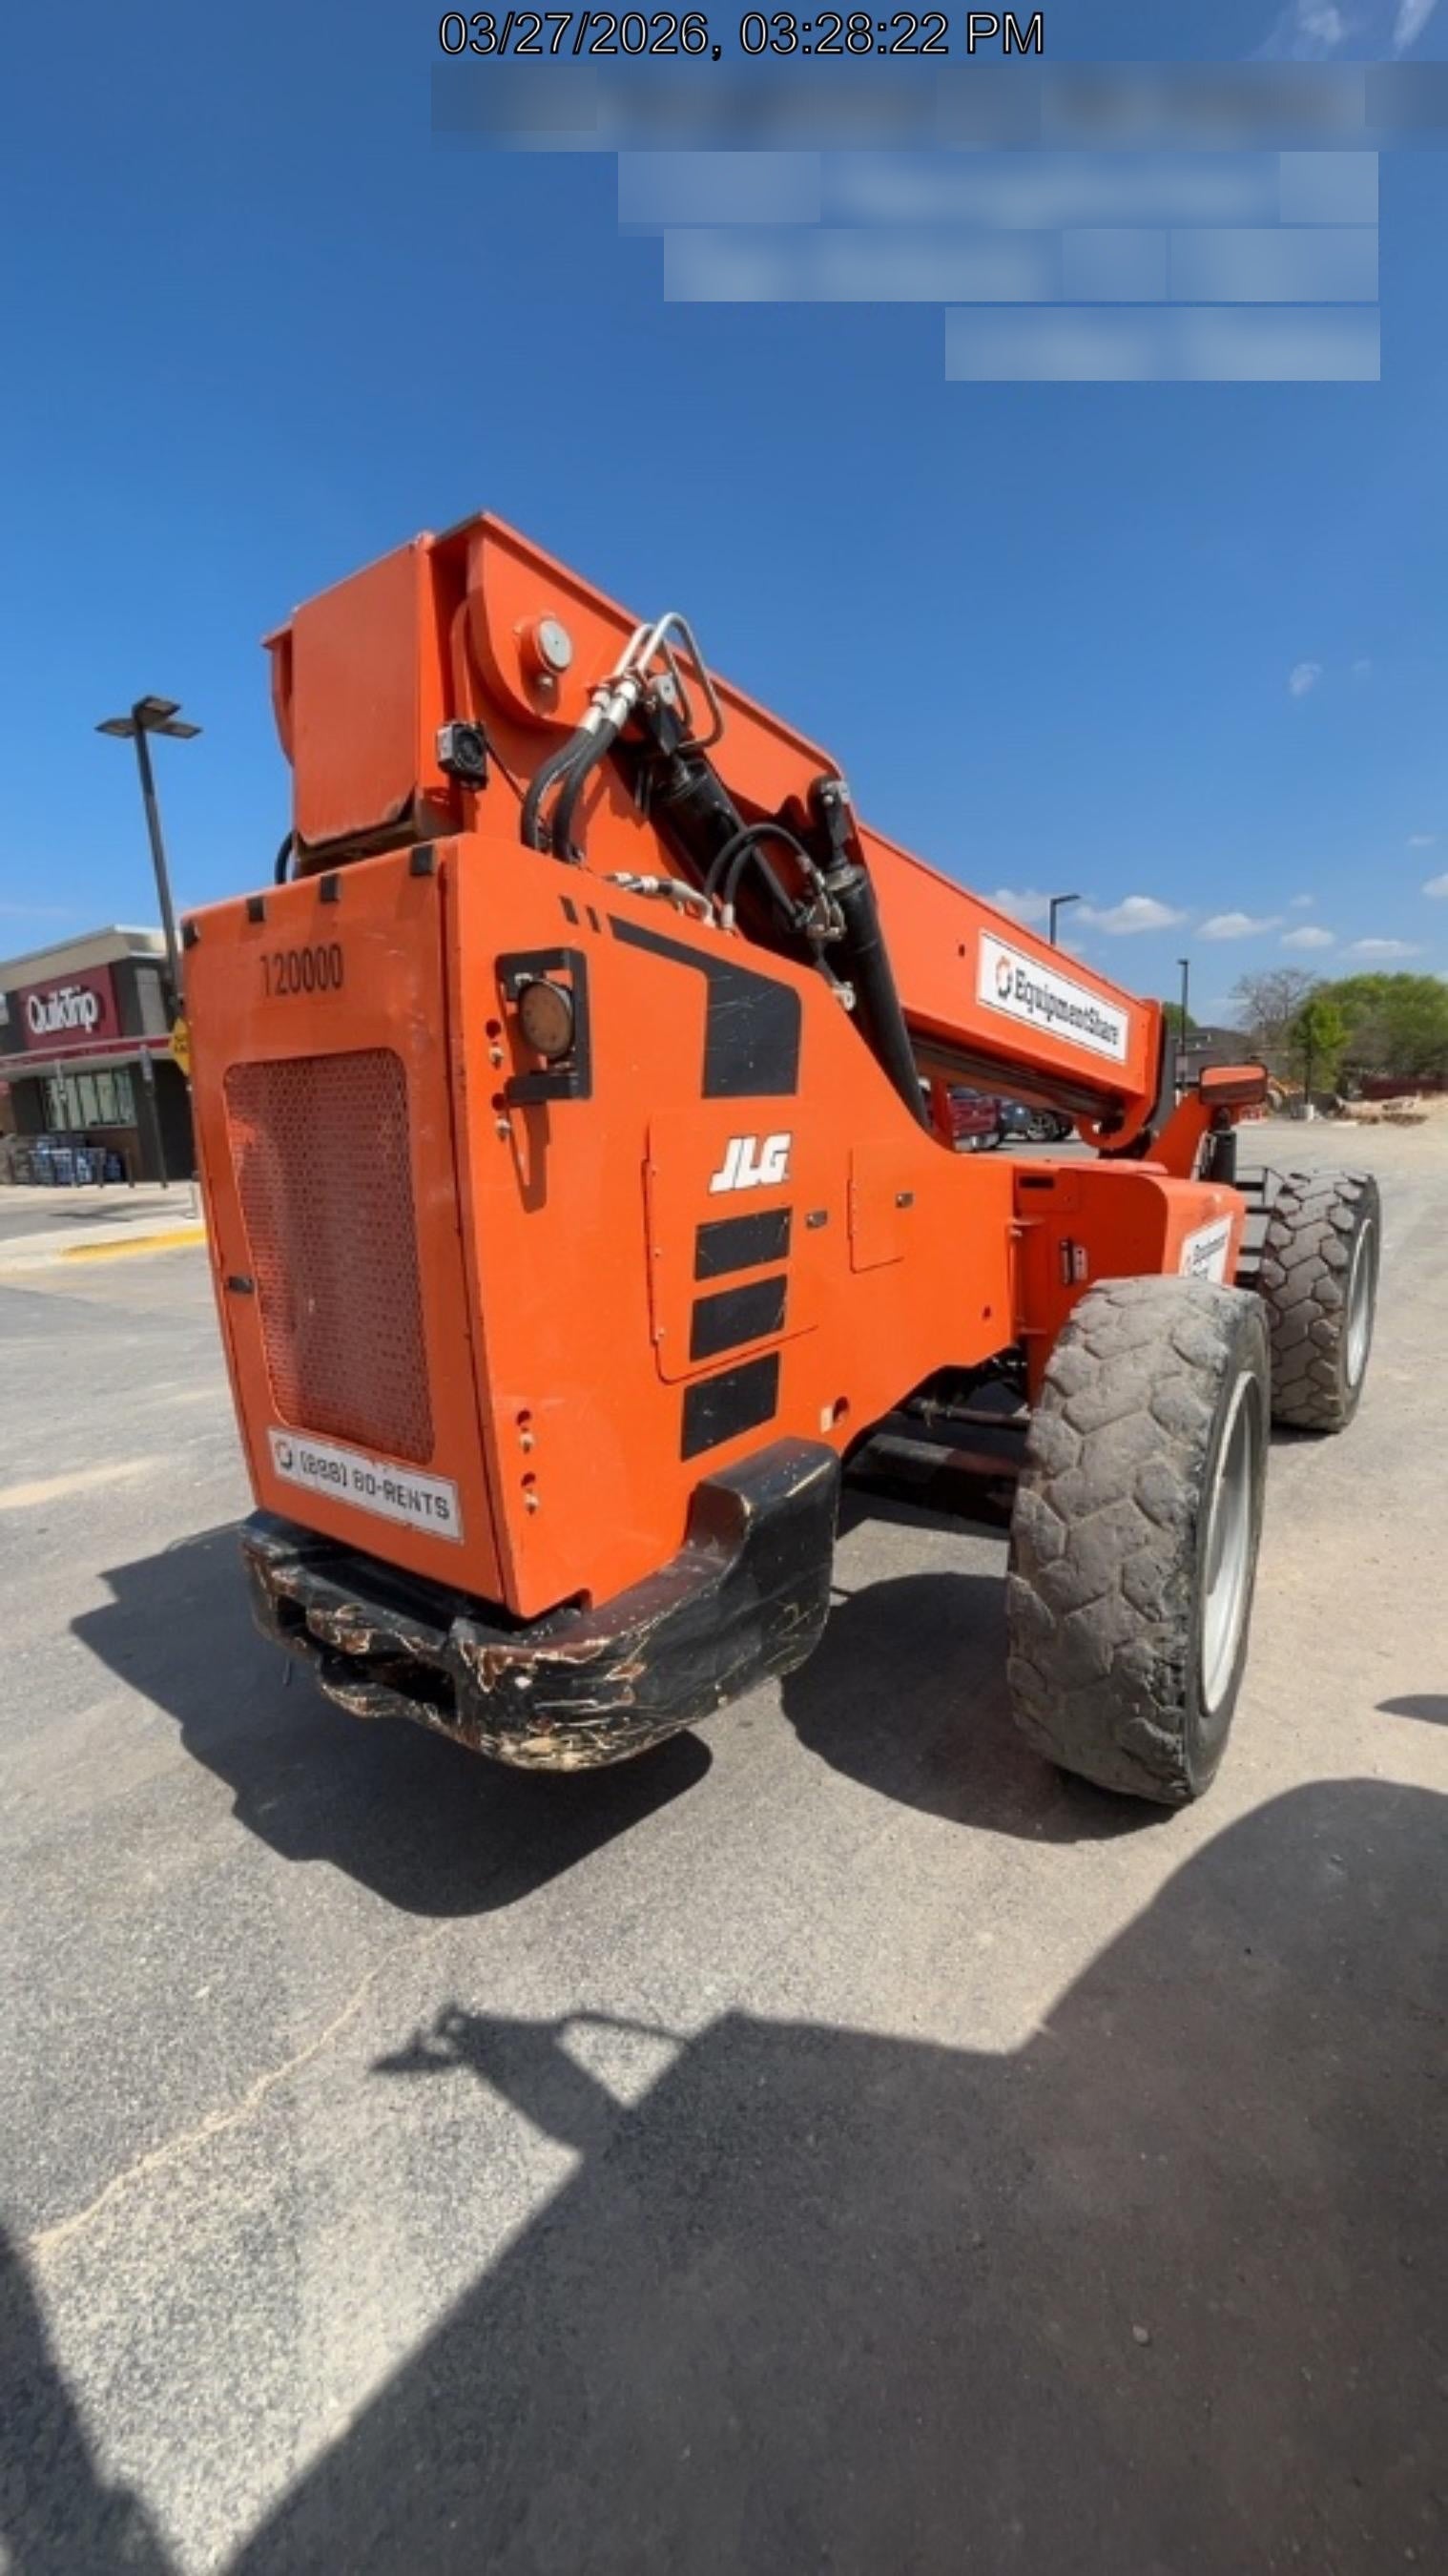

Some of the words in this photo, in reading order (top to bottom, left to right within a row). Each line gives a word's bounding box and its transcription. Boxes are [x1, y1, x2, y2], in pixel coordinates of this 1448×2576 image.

[259, 942, 344, 996] 120000
[28, 985, 98, 1034] QuikTrip
[1015, 968, 1119, 1046] EquipmentShare
[709, 1132, 792, 1194] JLG
[352, 1467, 450, 1520] 80-RENTS
